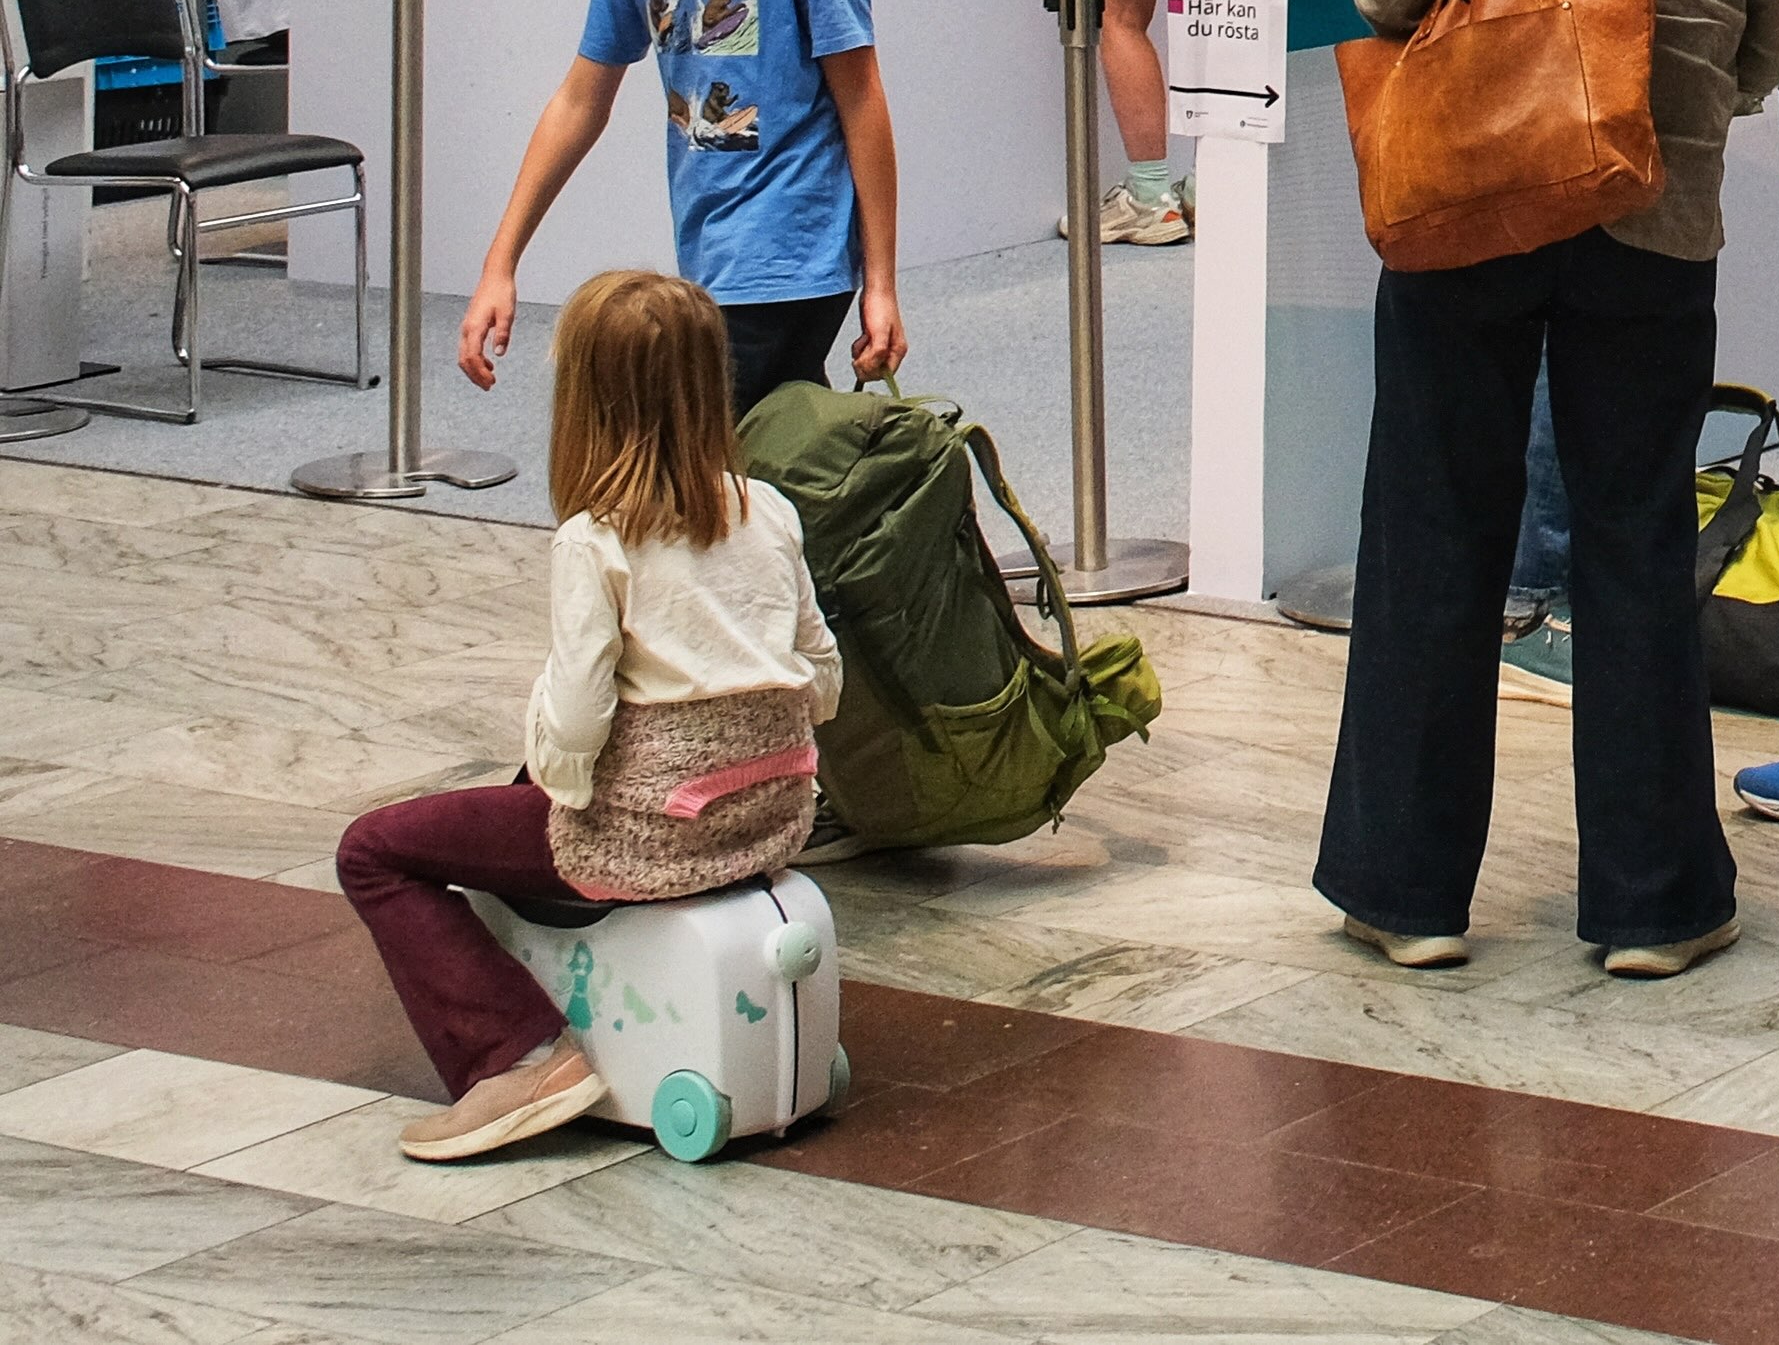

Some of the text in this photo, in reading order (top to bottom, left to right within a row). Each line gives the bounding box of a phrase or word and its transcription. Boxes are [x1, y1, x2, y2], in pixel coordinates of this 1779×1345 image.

[1227, 0, 1256, 19] kan
[1187, 20, 1259, 41] du rösta
